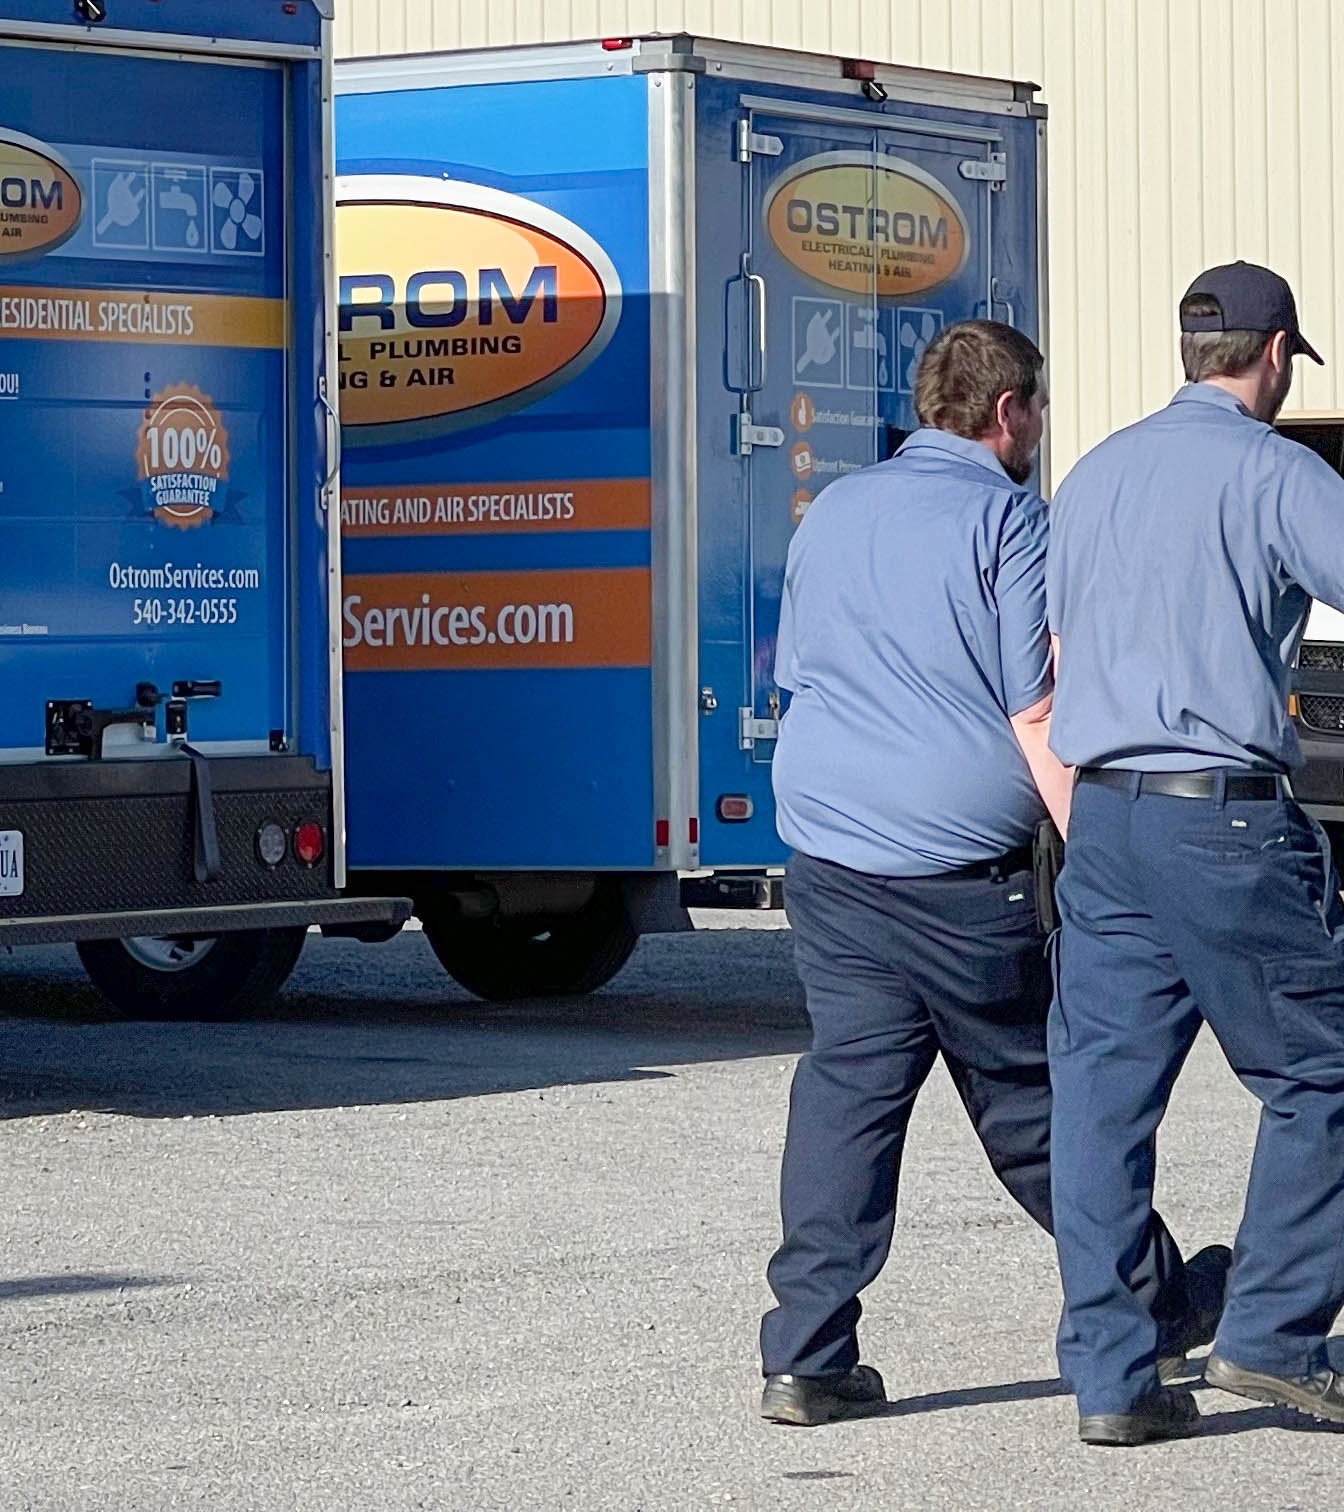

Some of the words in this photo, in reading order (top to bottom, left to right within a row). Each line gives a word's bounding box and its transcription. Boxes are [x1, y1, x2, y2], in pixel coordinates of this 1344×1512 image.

[2, 227, 22, 238] AIR
[787, 199, 948, 250] OSTROM
[802, 240, 873, 258] ELECTRICAL
[338, 265, 558, 331] ROM
[98, 301, 194, 336] SPECIALISTS
[370, 335, 522, 360] PLUMBING
[379, 370, 396, 388] &
[406, 367, 455, 387] AIR
[146, 427, 222, 469] 100%
[150, 473, 217, 493] SATISFACTION
[156, 489, 210, 506] GUARANTEE
[341, 499, 389, 525] ATING
[393, 497, 431, 524] AND
[434, 496, 465, 523] AIR
[467, 492, 575, 522] SPECIALISTS
[109, 562, 259, 589] OstromServices.com
[133, 598, 237, 625] 540-342-0555
[342, 593, 574, 648] Services.com
